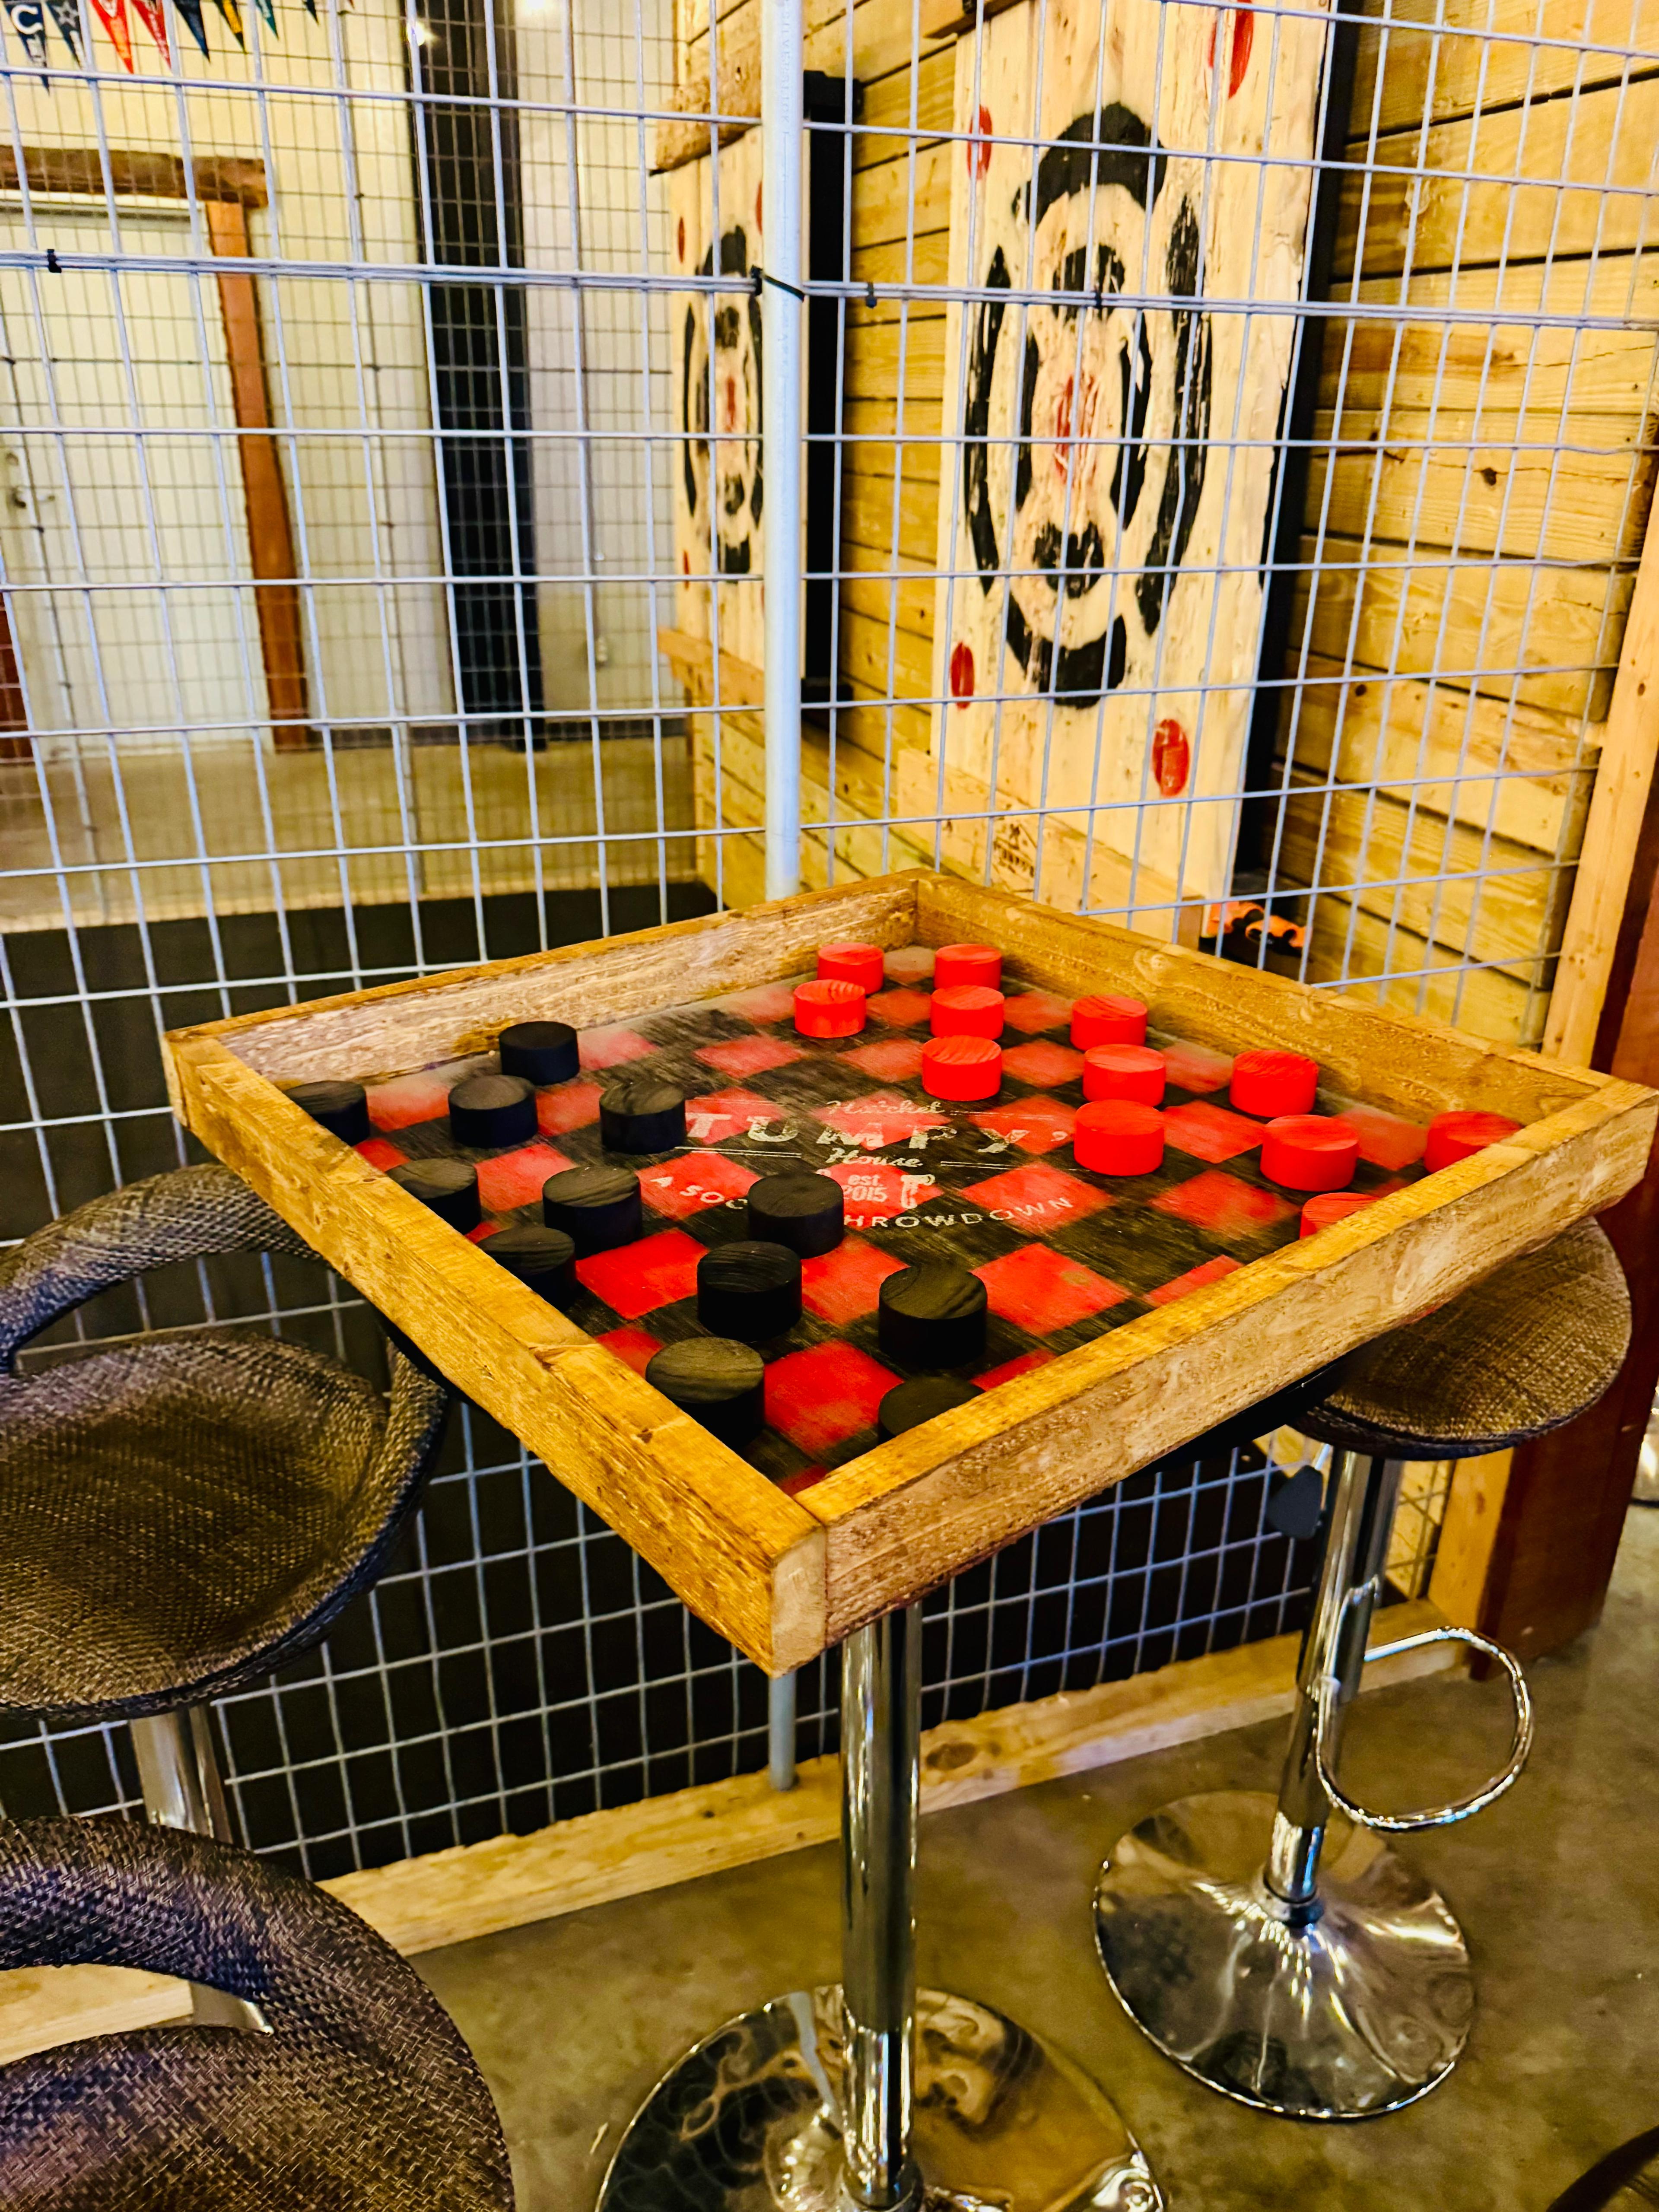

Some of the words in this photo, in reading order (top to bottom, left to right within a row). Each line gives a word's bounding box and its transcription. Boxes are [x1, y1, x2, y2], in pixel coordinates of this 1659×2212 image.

[11, 4, 42, 35] C
[826, 1100, 945, 1115] Hatchet
[685, 1112, 1070, 1153] TUMPY'
[825, 1147, 923, 1167] House
[848, 1174, 884, 1187] est.
[650, 1176, 674, 1187] A
[680, 1185, 748, 1210] SOC
[844, 1197, 1073, 1228] HROWDOWN
[842, 1185, 888, 1202] 2015
